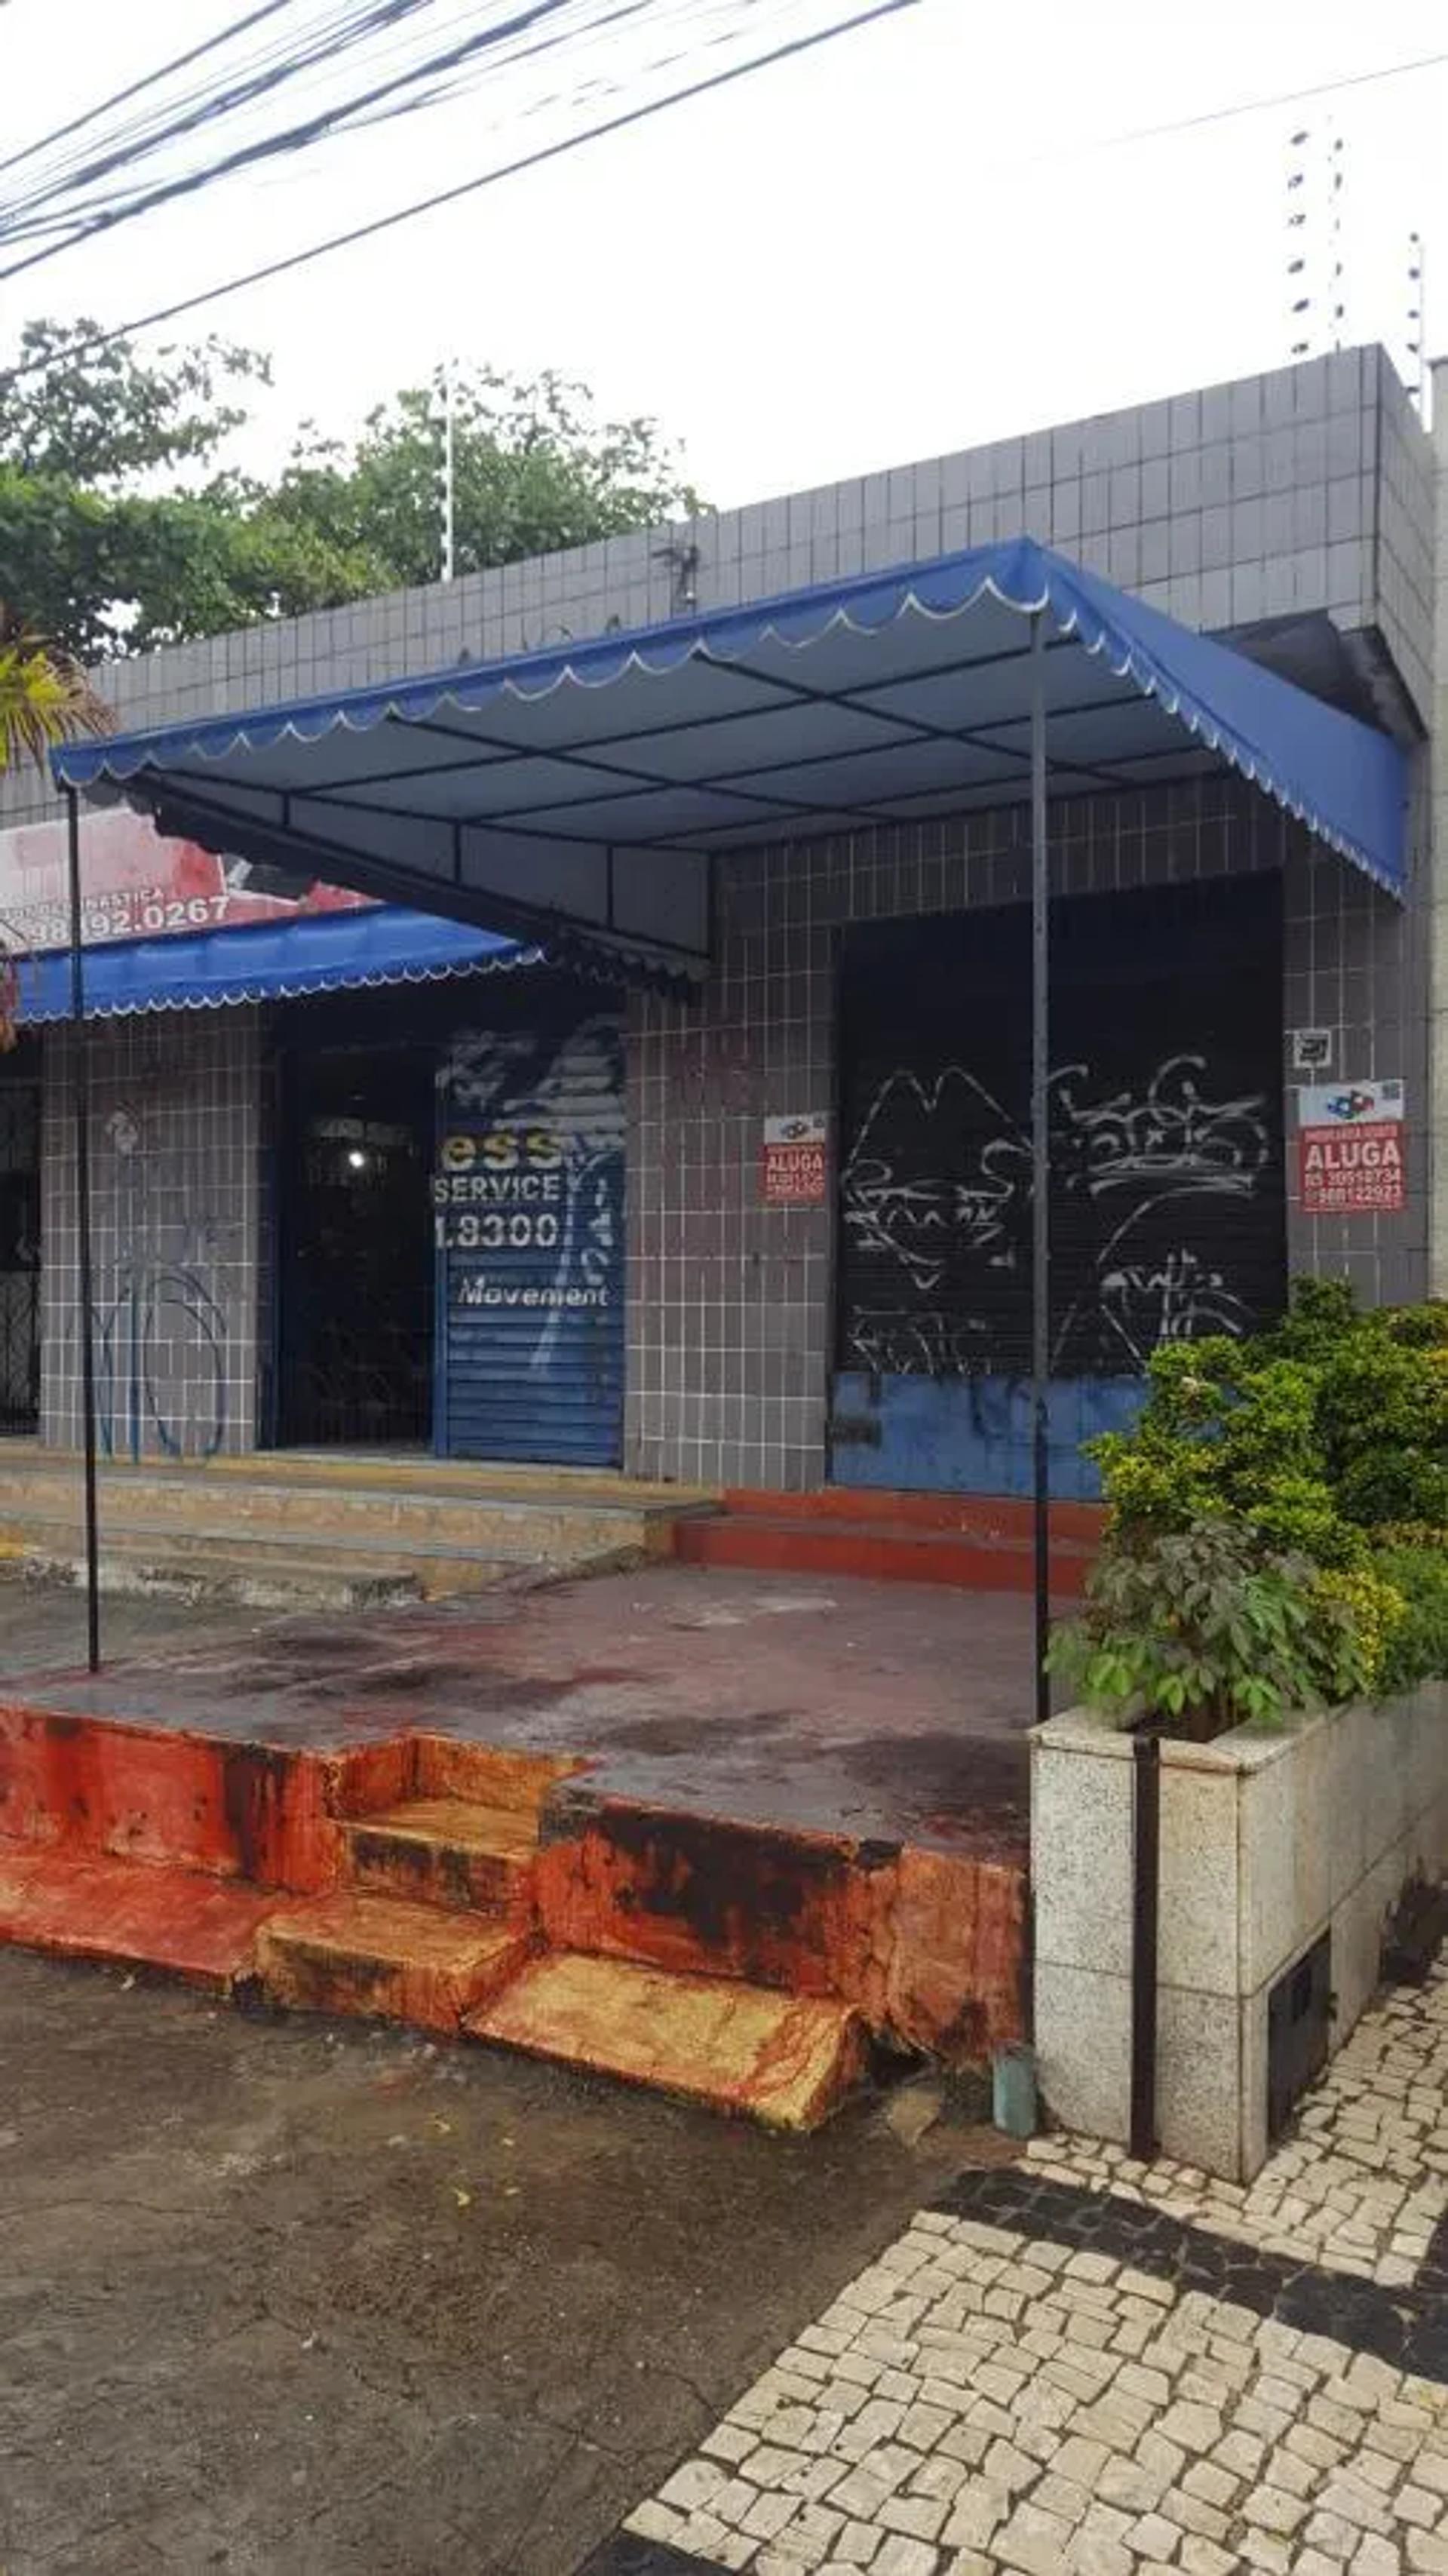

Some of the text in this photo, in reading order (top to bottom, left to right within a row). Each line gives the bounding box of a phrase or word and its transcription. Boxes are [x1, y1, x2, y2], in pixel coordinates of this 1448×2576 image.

[1304, 1138, 1400, 1170] ALUGA
[434, 1174, 561, 1203] SERVICE
[457, 1275, 609, 1306] Movement
